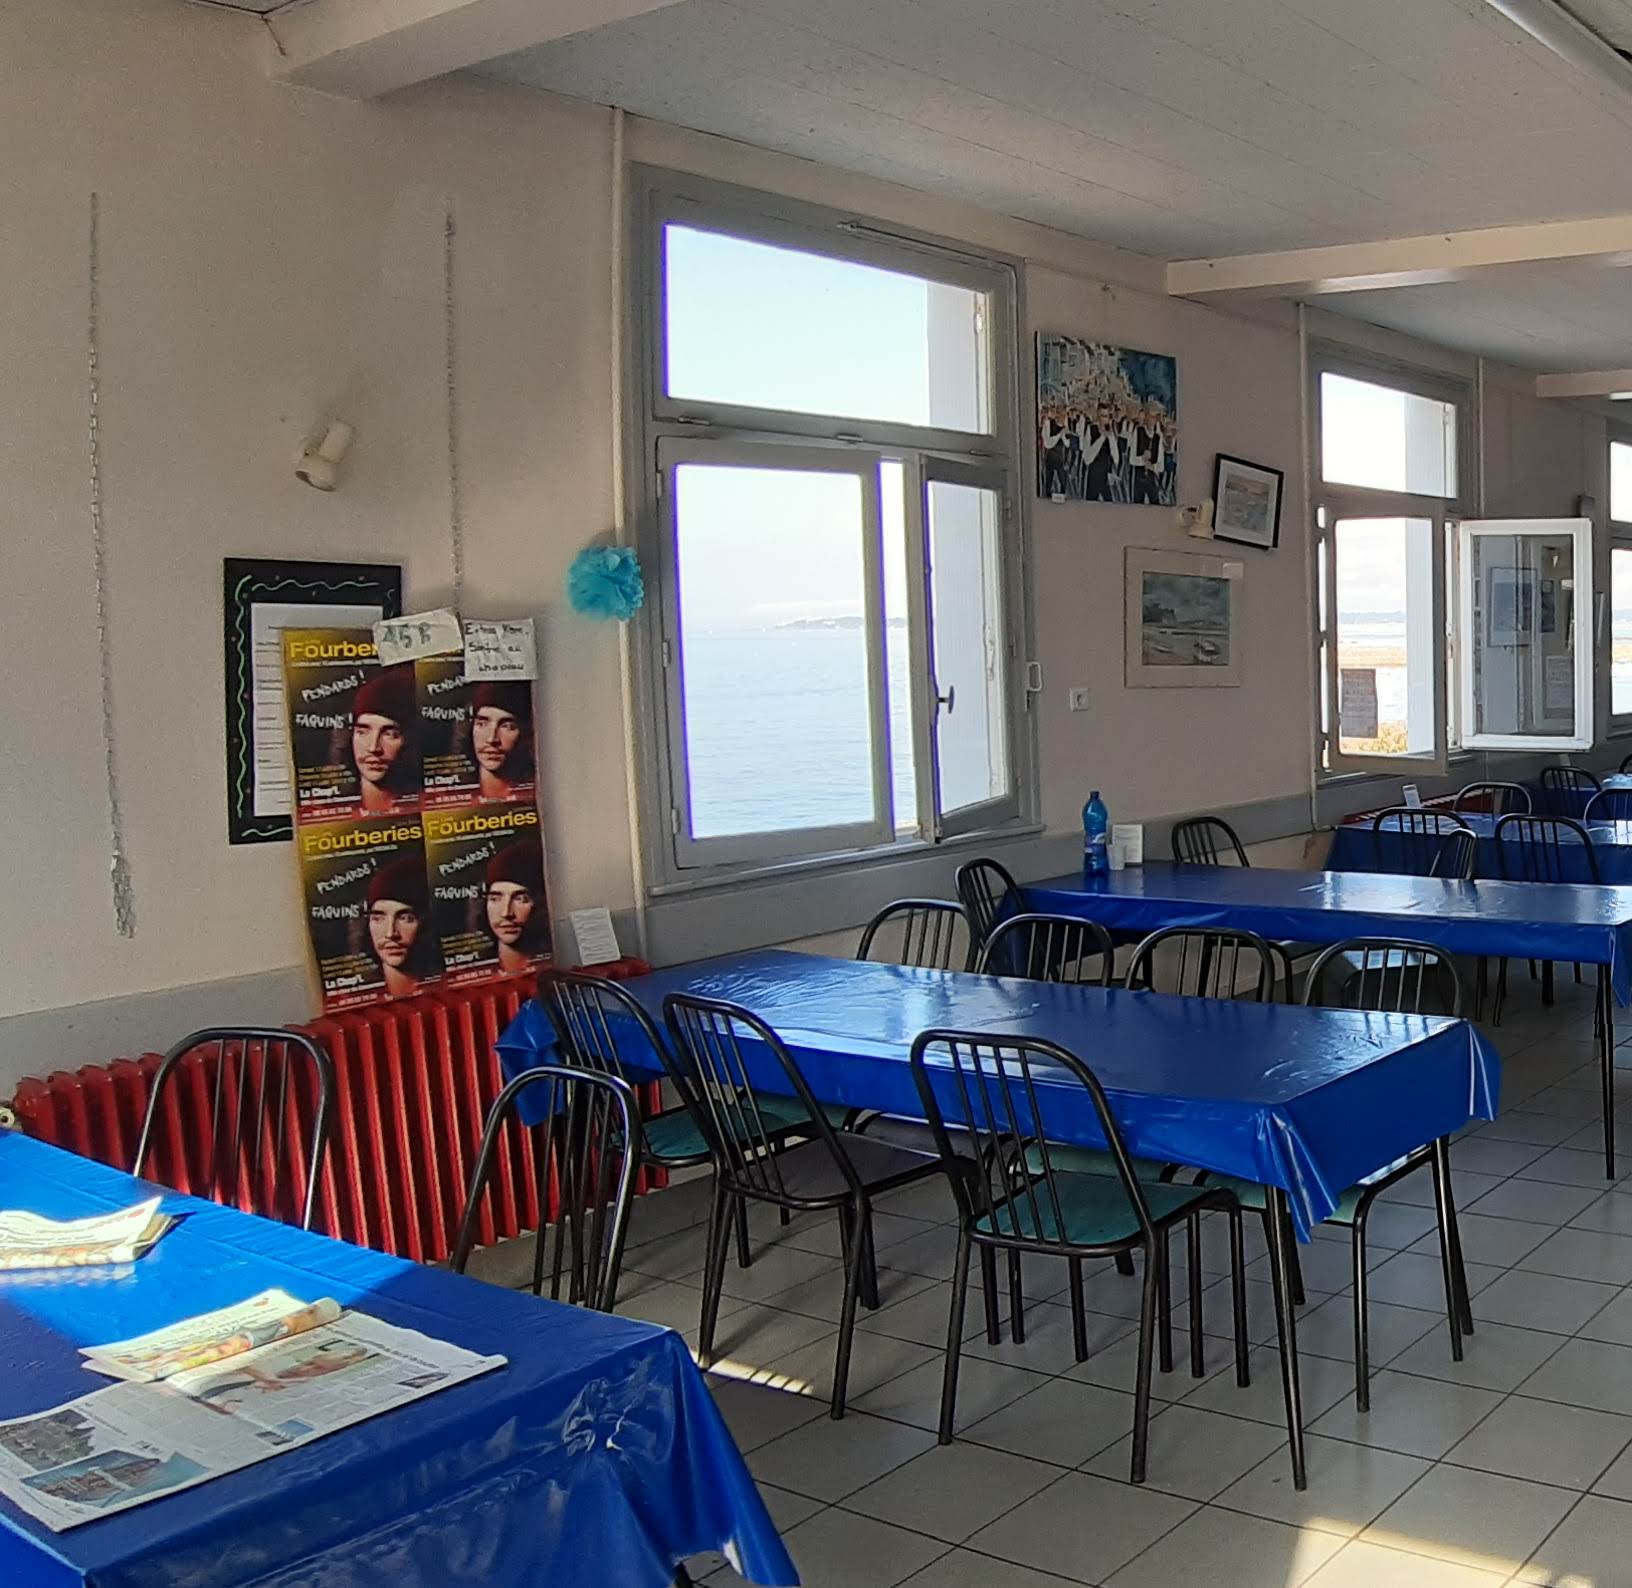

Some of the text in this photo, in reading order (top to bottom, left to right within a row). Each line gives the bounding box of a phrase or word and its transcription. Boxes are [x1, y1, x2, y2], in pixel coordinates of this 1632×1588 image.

[290, 640, 380, 659] Fourber
[301, 675, 358, 703] PENDARDS
[295, 713, 345, 730] FAQUINS
[421, 705, 466, 722] FAQUINS
[427, 811, 538, 837] Fourberies
[304, 825, 423, 852] Fourberies
[438, 846, 490, 877] PENDARDS
[316, 863, 371, 896] PENDARDS
[434, 884, 479, 900] FAQUINS
[311, 903, 360, 920] FAQUINS
